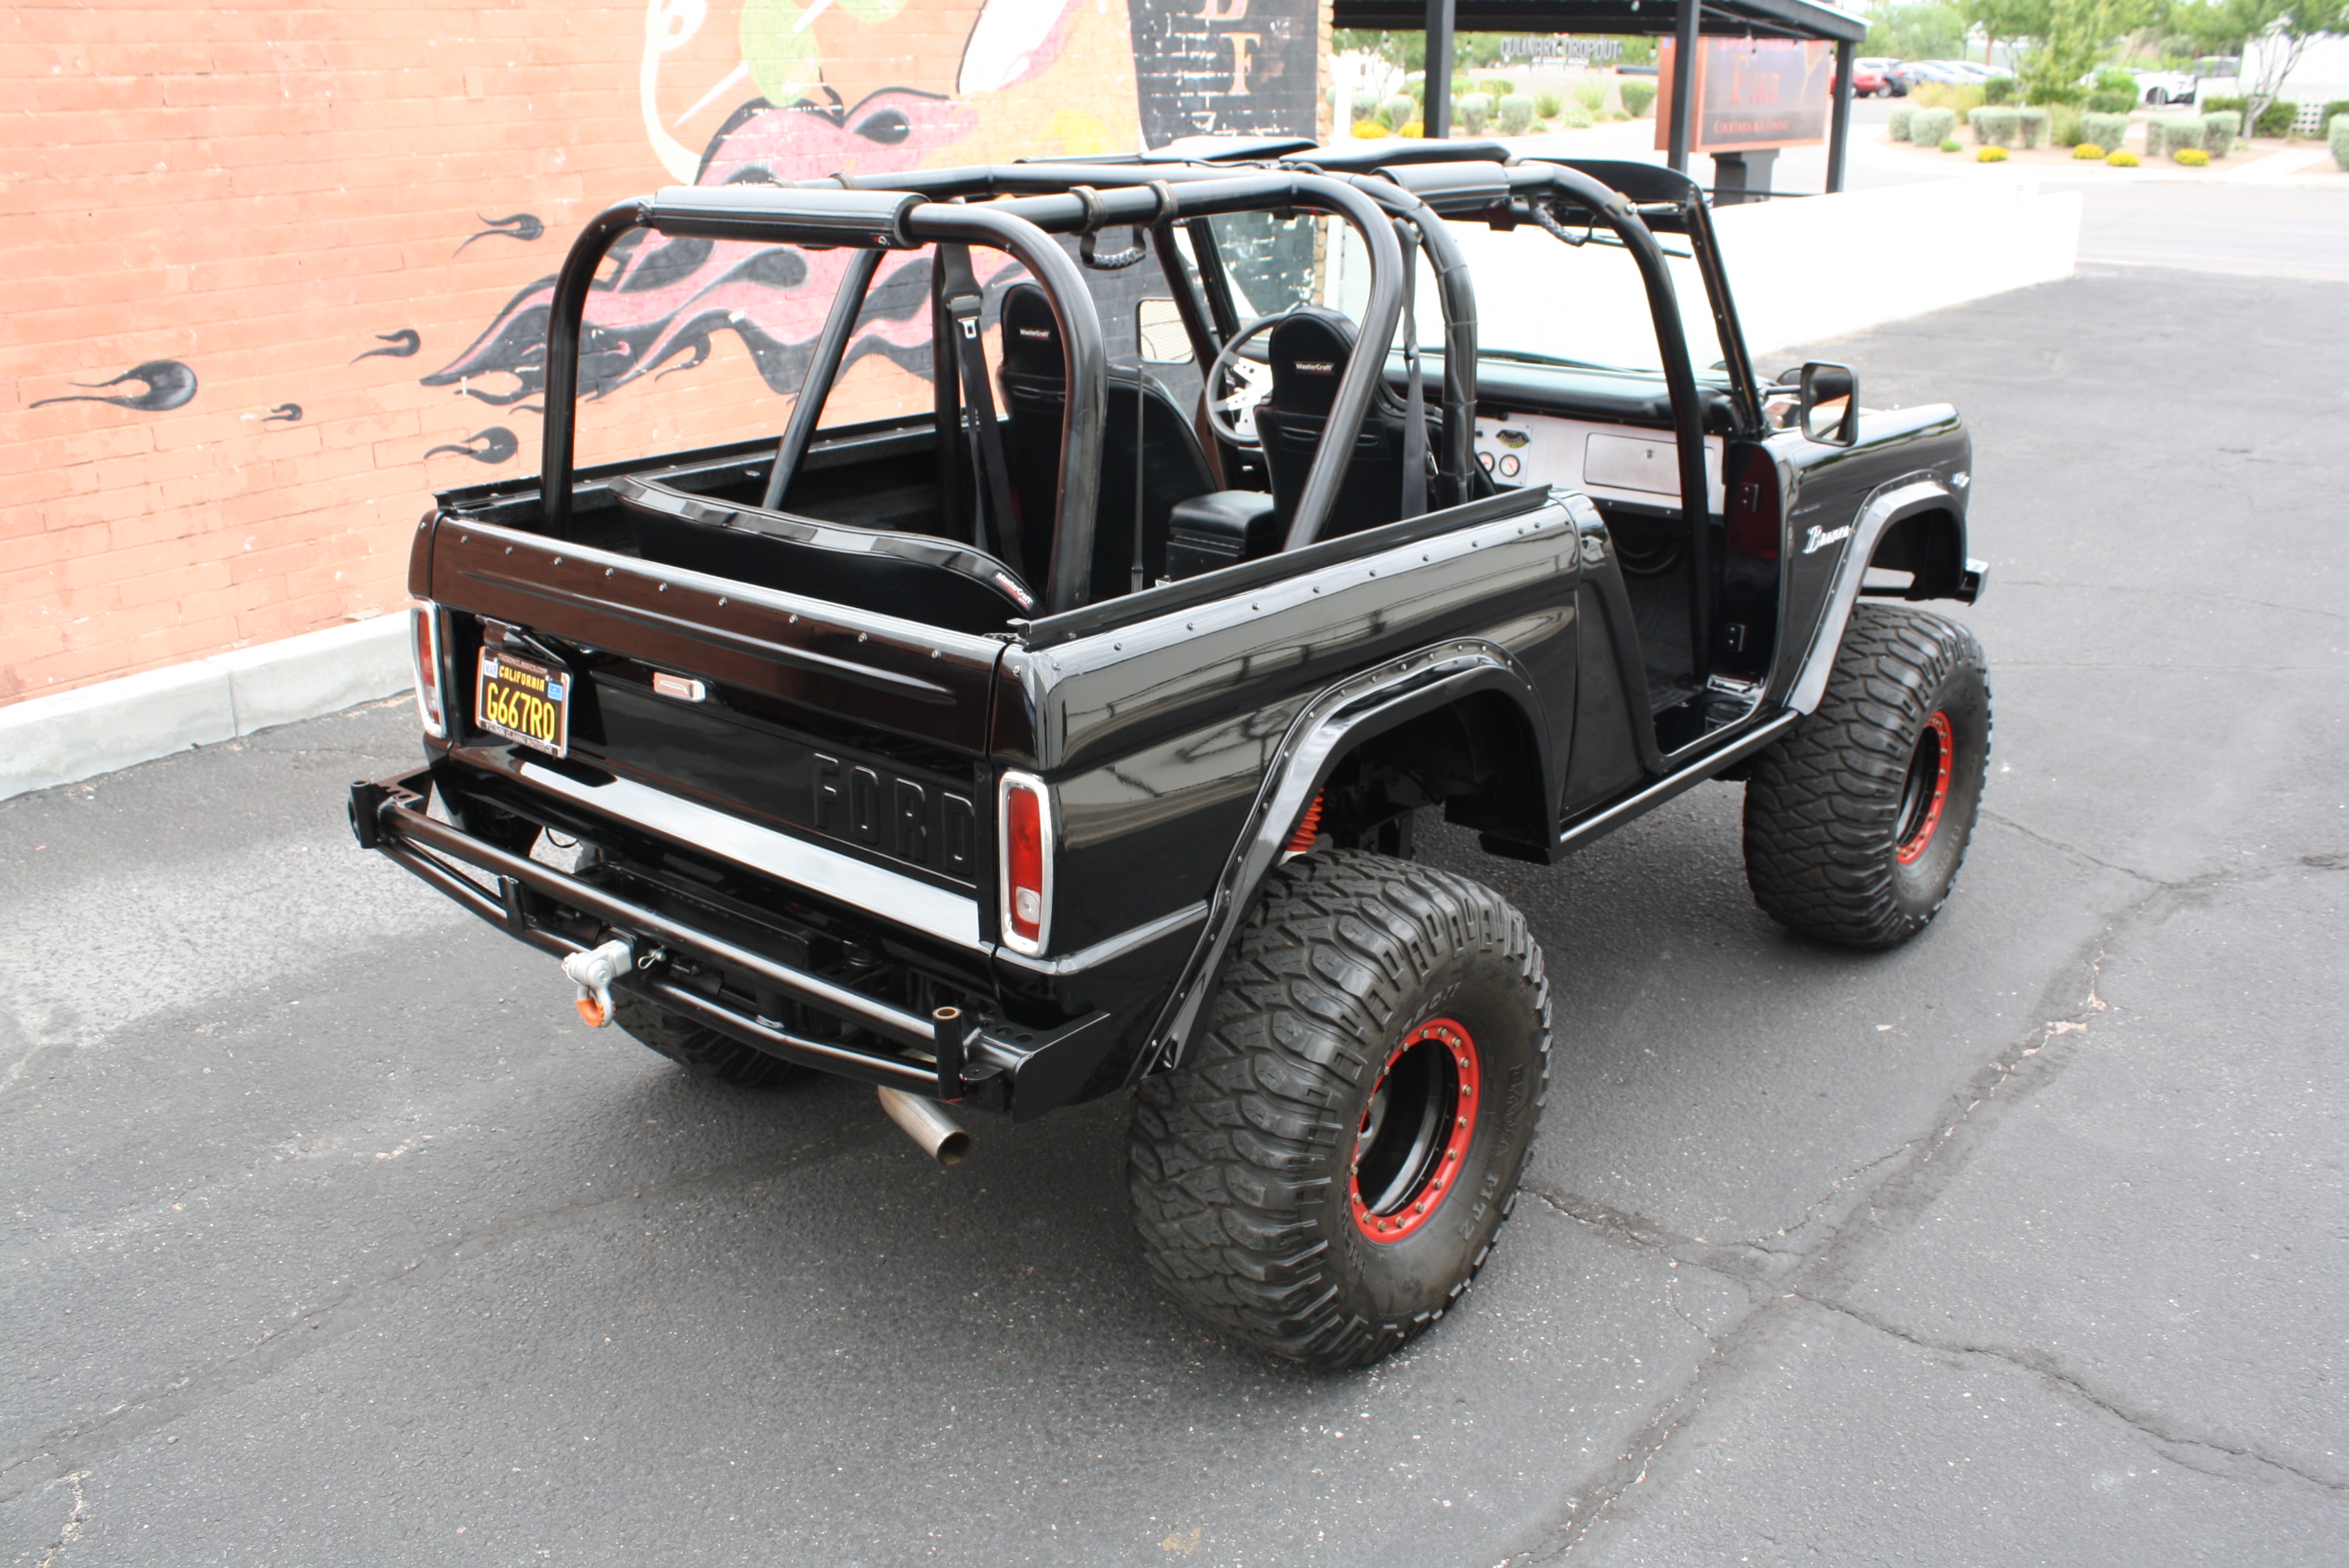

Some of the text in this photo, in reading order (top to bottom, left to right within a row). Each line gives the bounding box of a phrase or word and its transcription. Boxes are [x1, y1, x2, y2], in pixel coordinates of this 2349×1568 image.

[1501, 38, 1620, 59] CULINARY DROPOUT
[996, 572, 1034, 604] MasterCraft
[485, 661, 498, 676] MAR
[499, 665, 545, 692] CALIFORNIA
[813, 752, 974, 877] FORD
[1458, 1172, 1500, 1241] MTZ
